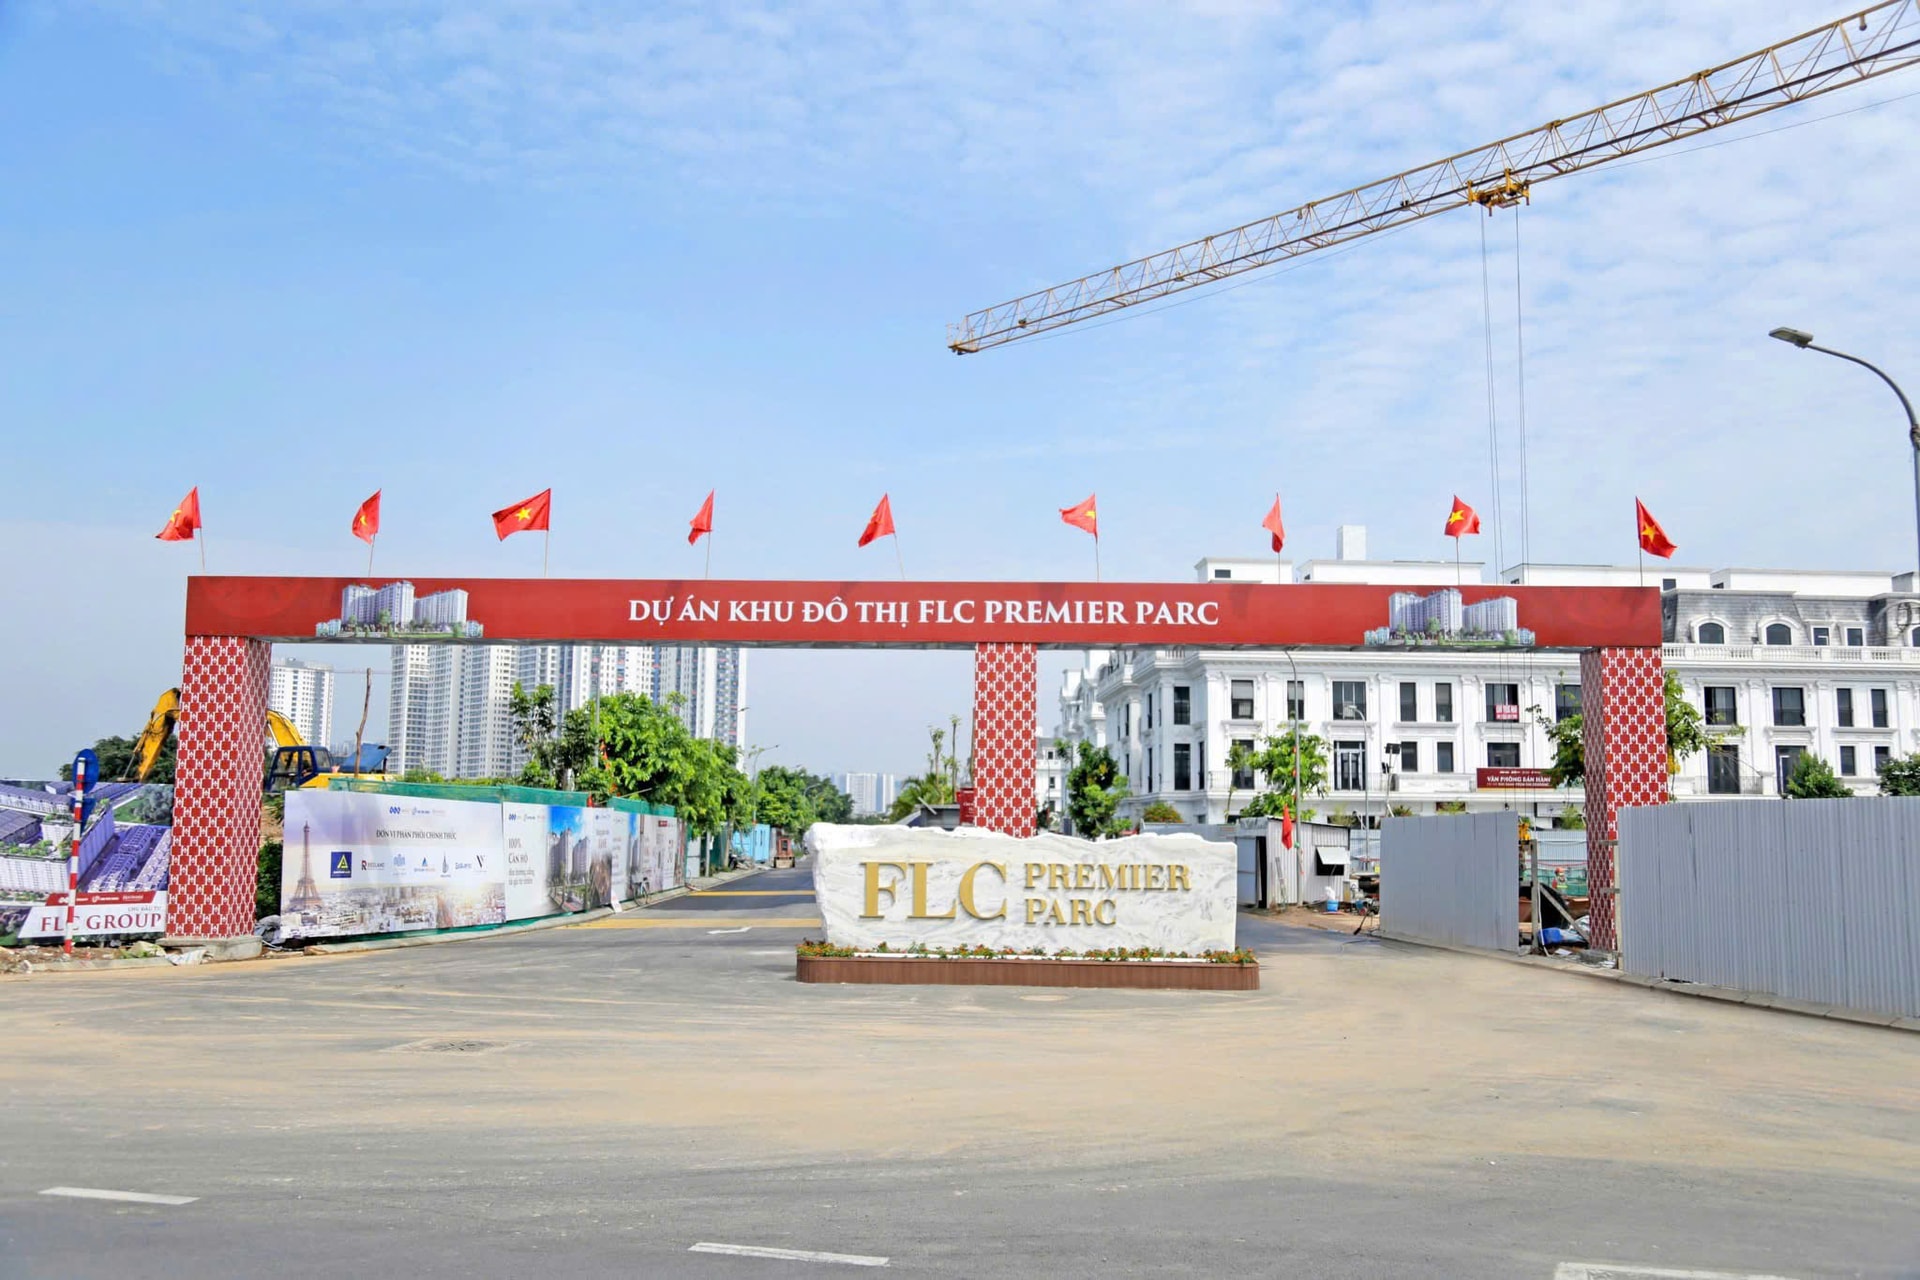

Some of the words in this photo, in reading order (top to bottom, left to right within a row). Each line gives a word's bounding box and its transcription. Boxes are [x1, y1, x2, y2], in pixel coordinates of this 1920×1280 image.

[628, 596, 675, 626] DỰ
[677, 594, 720, 622] ÁN
[728, 600, 794, 622] KHU
[802, 596, 848, 623] ĐÔ
[854, 601, 909, 628] THỊ
[918, 599, 975, 623] FLC
[984, 600, 1129, 625] PREMIER
[1135, 601, 1219, 626] PARC
[859, 861, 1008, 921] FLC
[1024, 862, 1192, 891] PREMIER
[86, 913, 161, 931] GROUP
[1024, 898, 1117, 926] PARC
